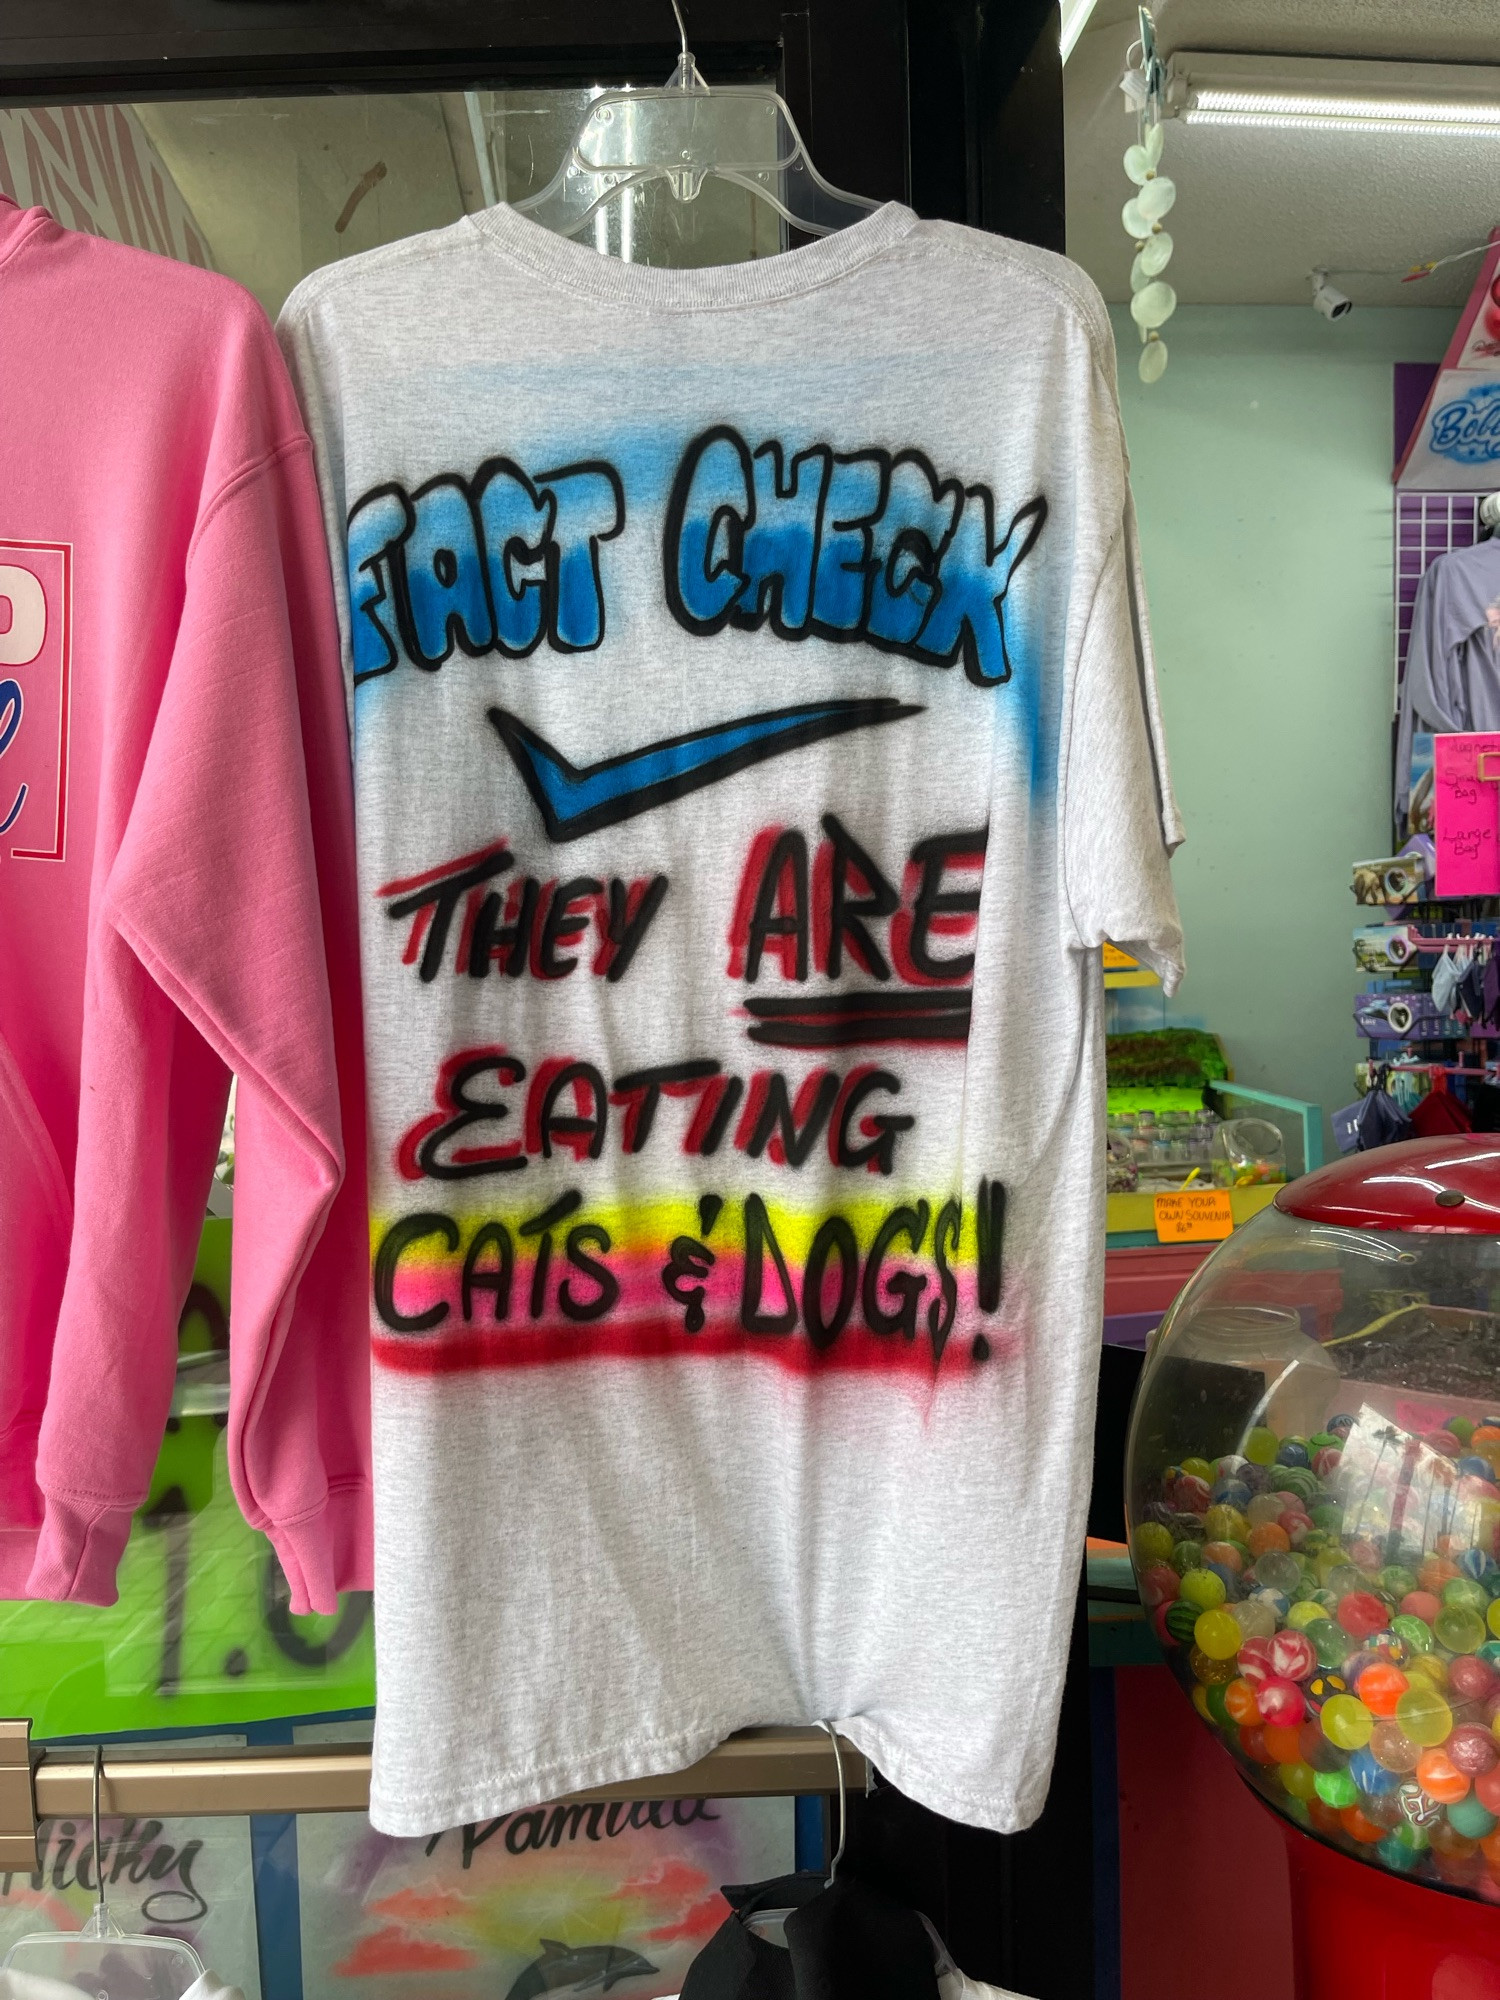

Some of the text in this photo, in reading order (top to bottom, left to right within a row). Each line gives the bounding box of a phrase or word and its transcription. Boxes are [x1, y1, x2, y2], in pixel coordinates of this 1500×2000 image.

[347, 424, 1049, 688] FACT CHECK
[375, 811, 990, 986] THEY ARE
[392, 1043, 916, 1182] EATING
[373, 1188, 621, 1335] CATS
[1159, 1209, 1232, 1221] OWN SOUVENIR
[1188, 1195, 1217, 1207] YOUR
